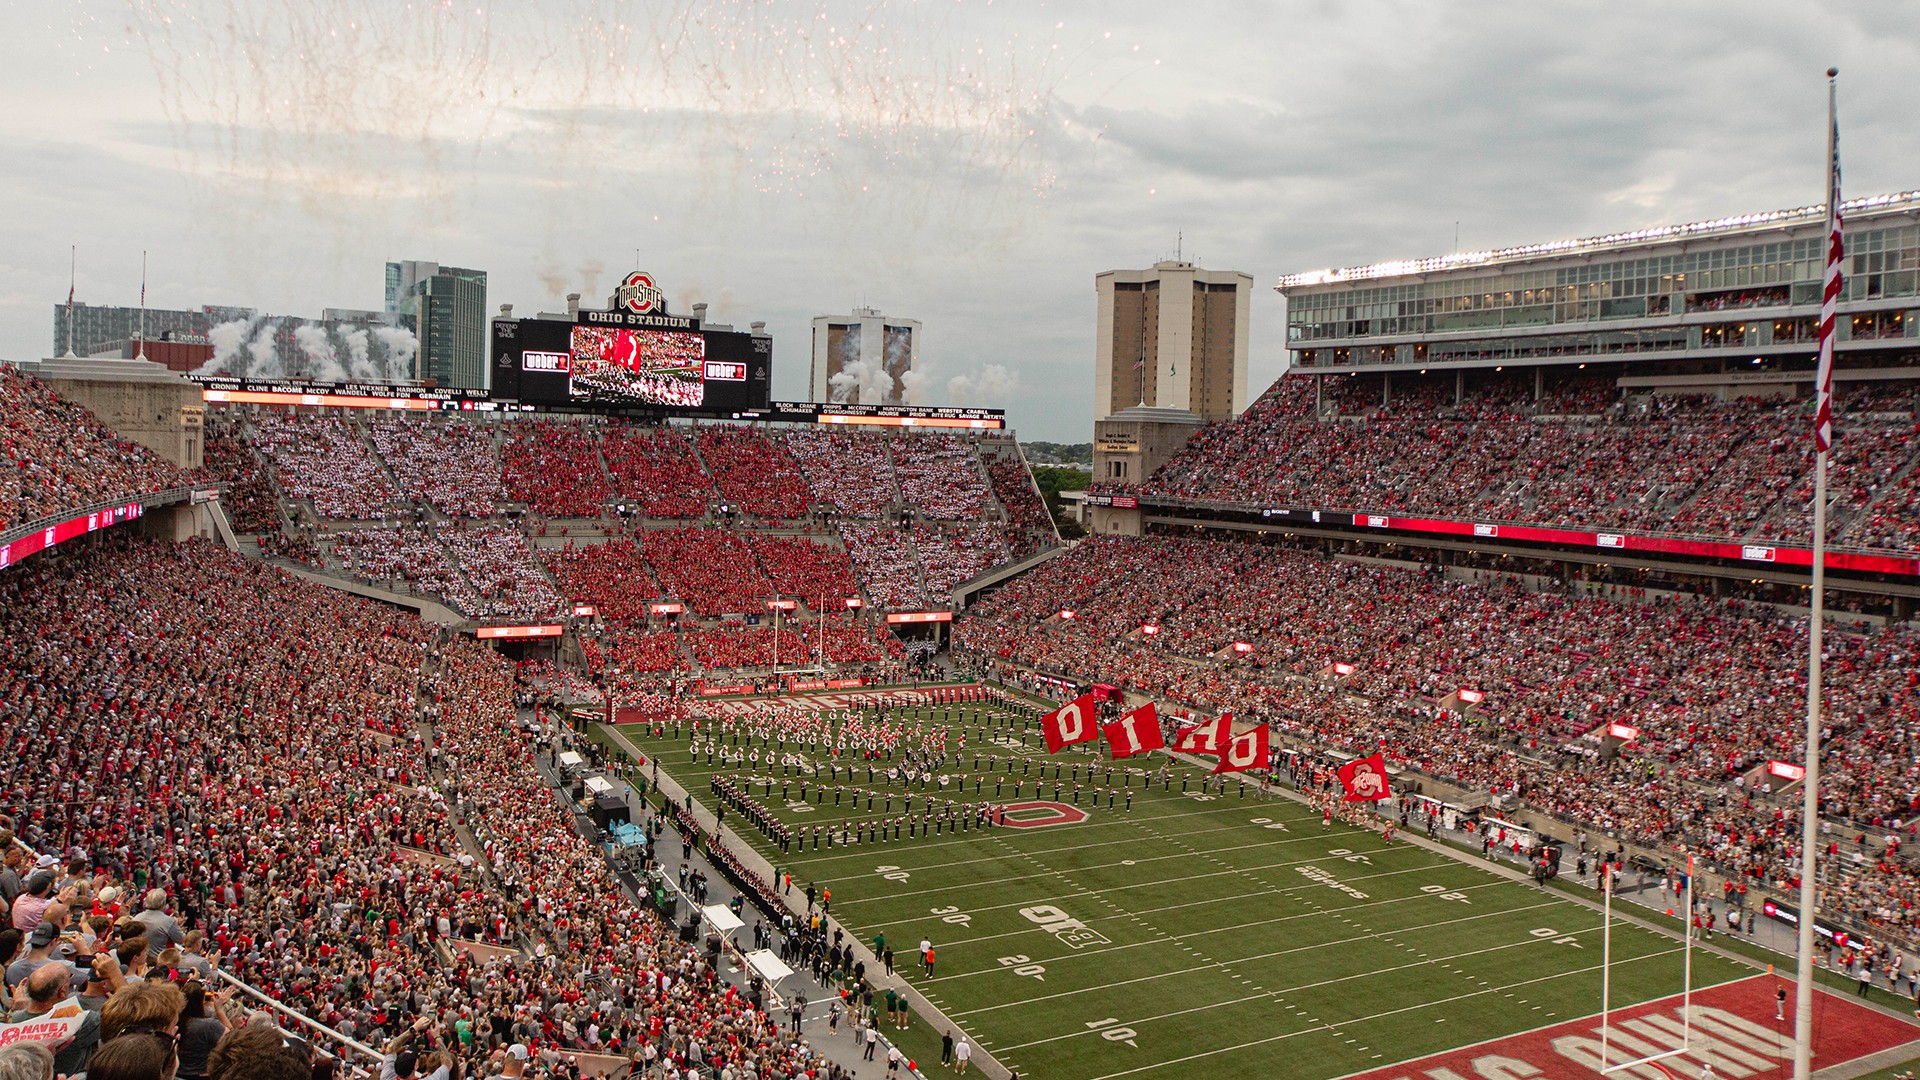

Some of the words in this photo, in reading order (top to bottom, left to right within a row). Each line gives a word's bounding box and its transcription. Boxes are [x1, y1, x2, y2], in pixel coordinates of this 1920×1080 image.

[589, 312, 622, 323] OHIO
[627, 314, 691, 328] STADIUM
[526, 353, 559, 369] weber
[707, 363, 736, 378] weber
[1056, 703, 1083, 742] O
[1121, 715, 1142, 753] I
[1228, 732, 1257, 768] O
[875, 865, 910, 881] 40
[1294, 867, 1369, 899] Safelite
[1420, 885, 1468, 901] 20
[930, 905, 972, 924] 30
[997, 955, 1046, 977] 20
[21, 1023, 59, 1034] HAVE
[59, 1023, 68, 1032] A
[1085, 1017, 1138, 1042] 10
